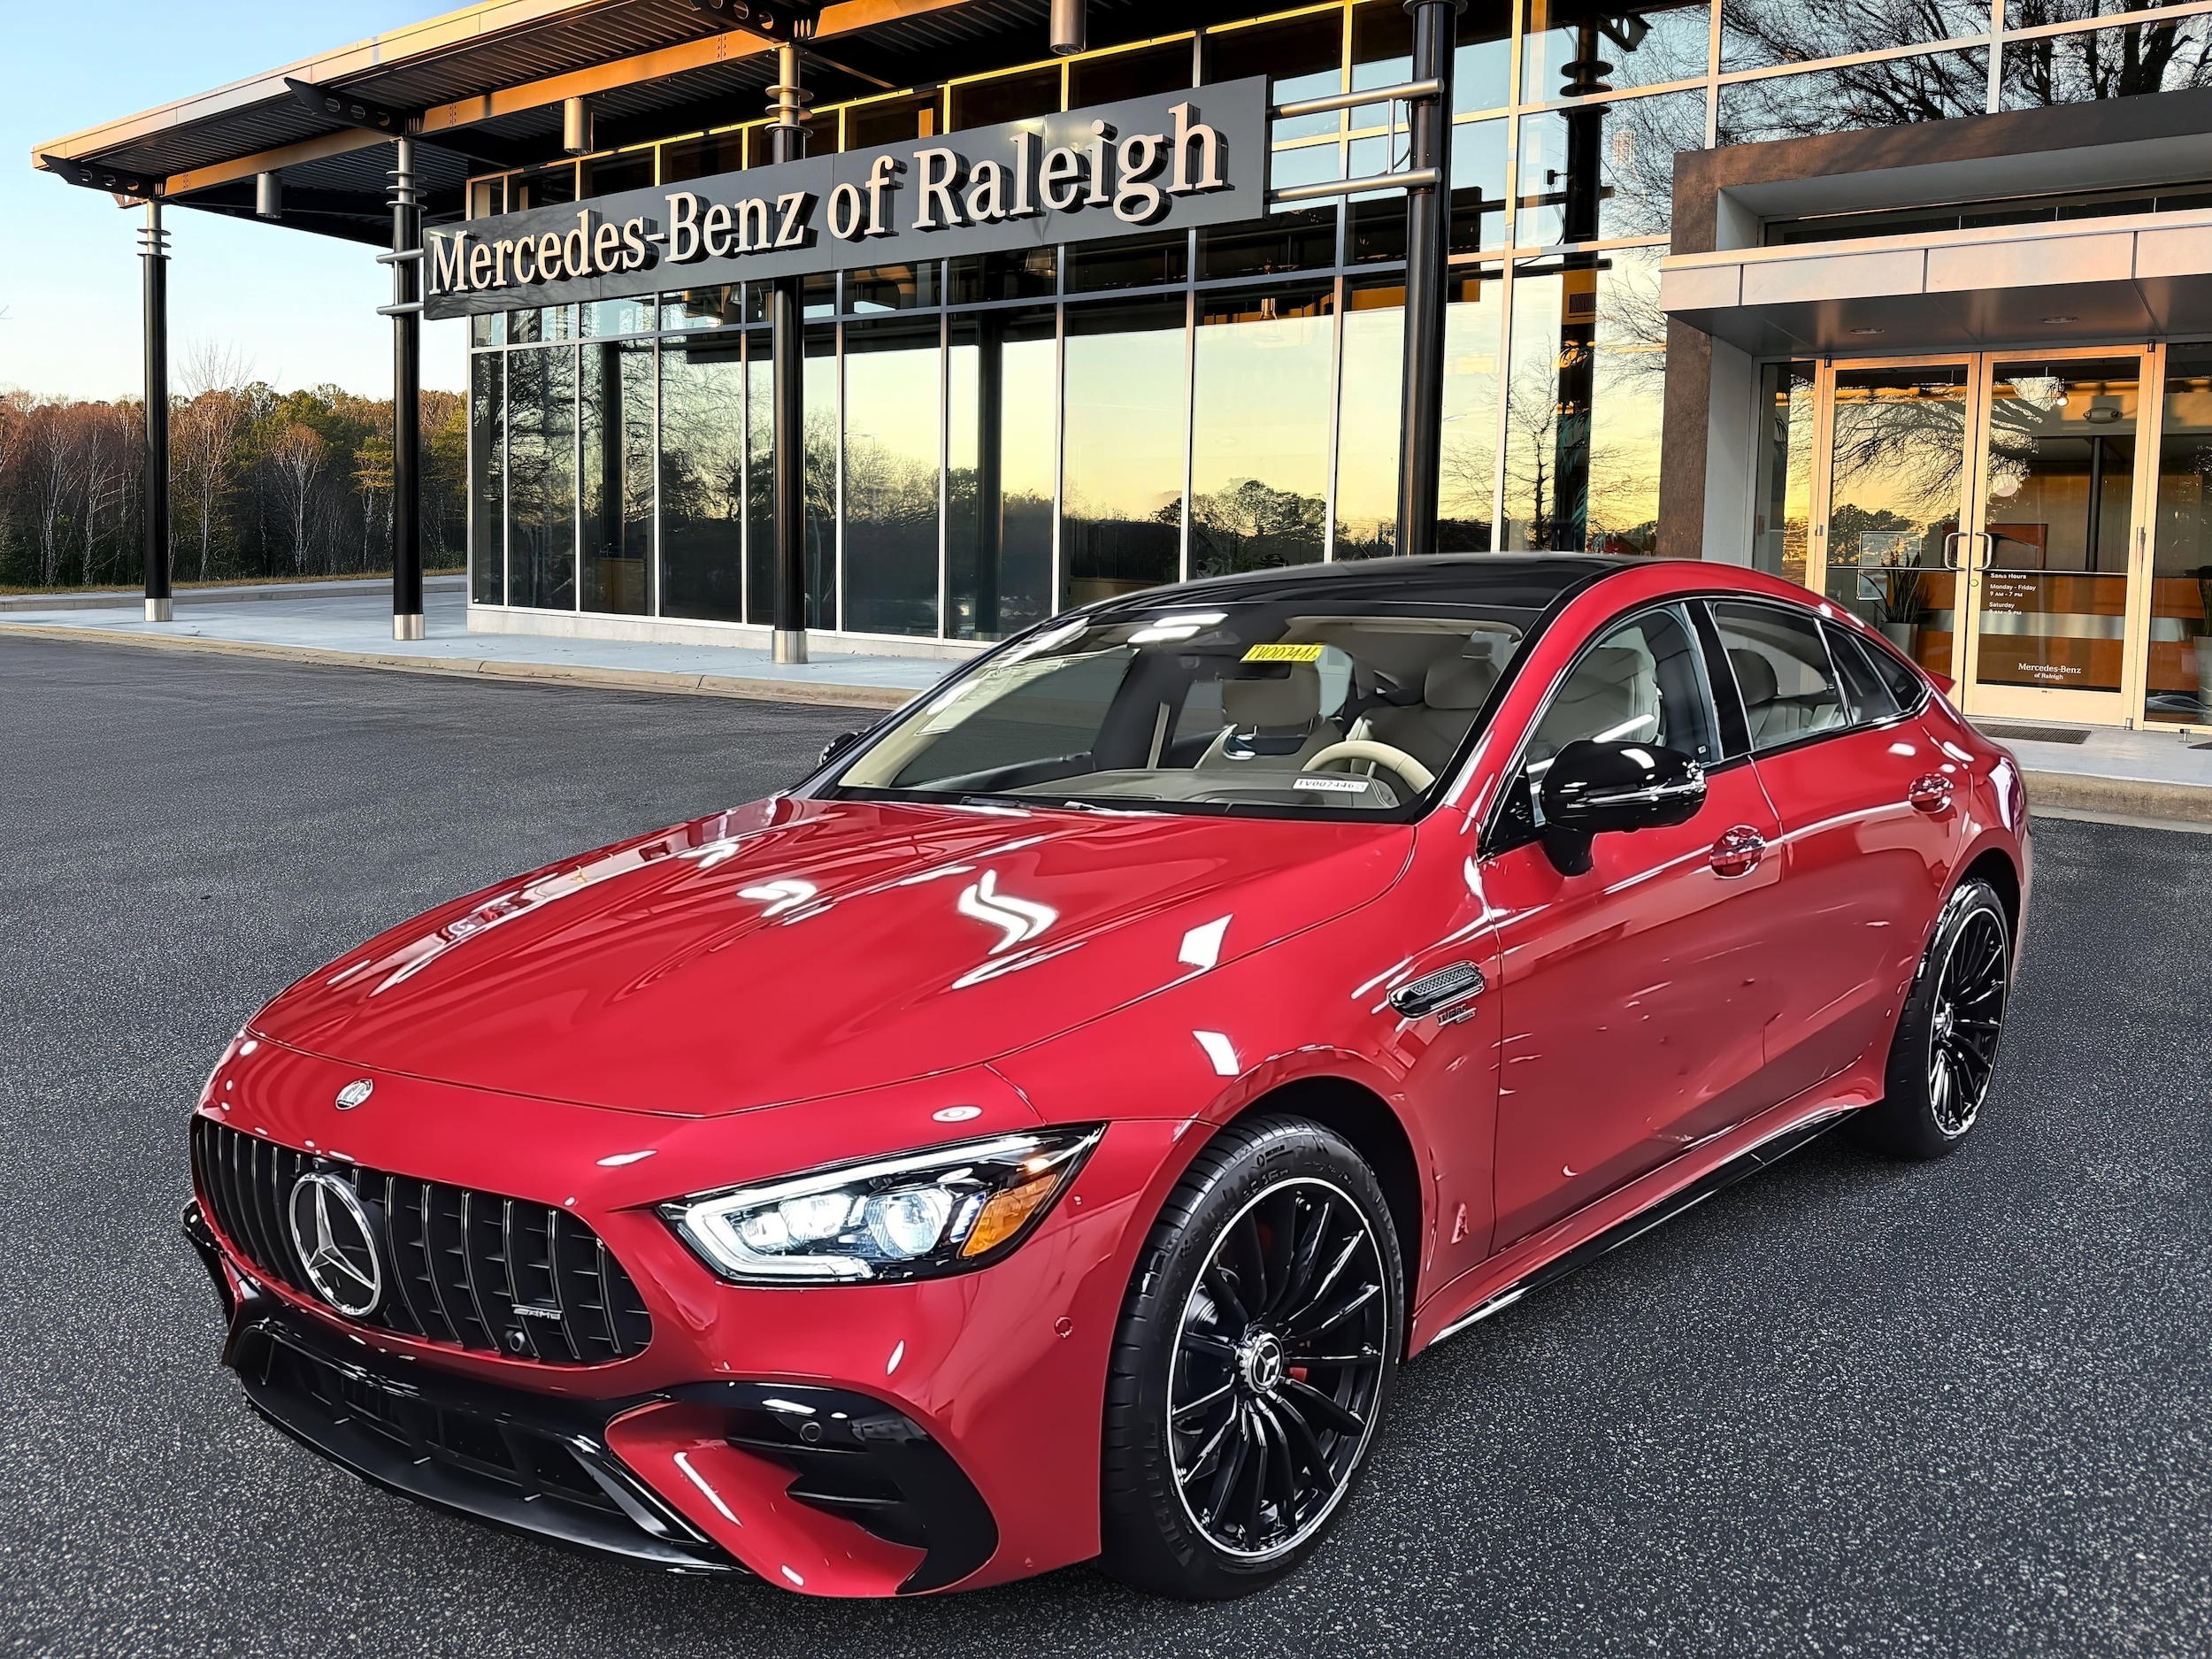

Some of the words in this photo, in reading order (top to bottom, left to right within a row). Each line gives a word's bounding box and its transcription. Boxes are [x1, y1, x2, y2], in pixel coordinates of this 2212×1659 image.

[429, 191, 807, 296] Mercedes-Benz
[826, 155, 896, 240] of
[912, 102, 1225, 230] Raleigh
[2017, 663, 2082, 674] Mercedes-Benz
